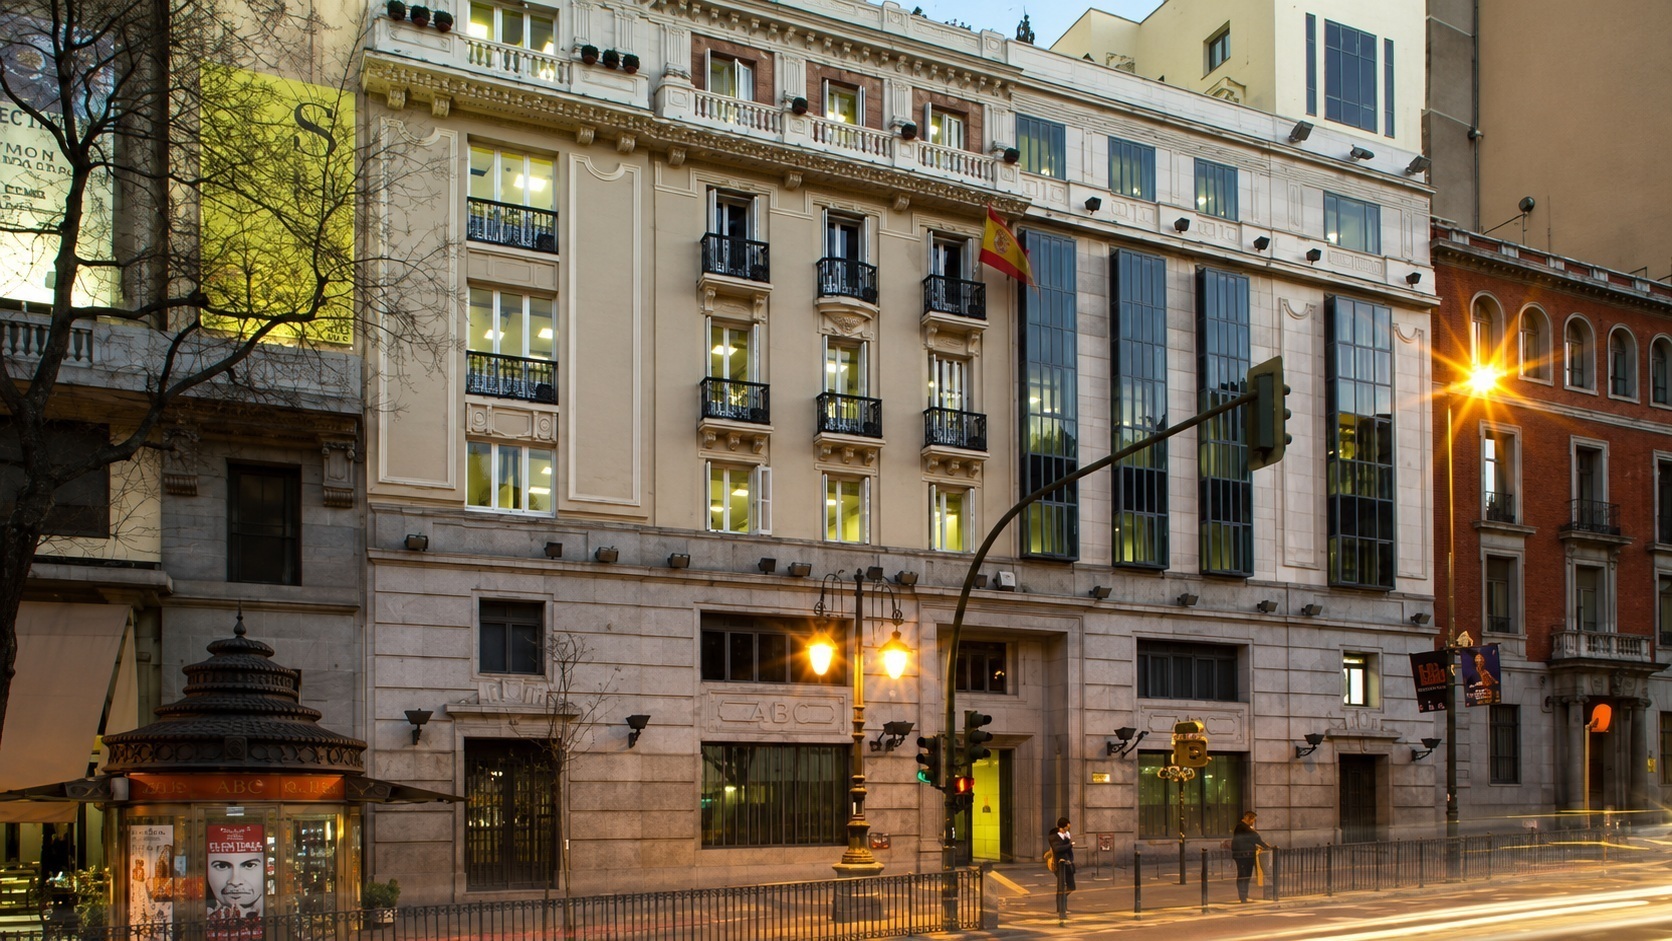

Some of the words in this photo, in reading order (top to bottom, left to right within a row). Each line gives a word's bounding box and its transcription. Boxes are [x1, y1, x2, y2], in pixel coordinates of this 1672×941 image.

[294, 102, 336, 157] S
[0, 140, 55, 162] MON
[749, 700, 809, 724] ABC
[216, 780, 264, 794] ABC
